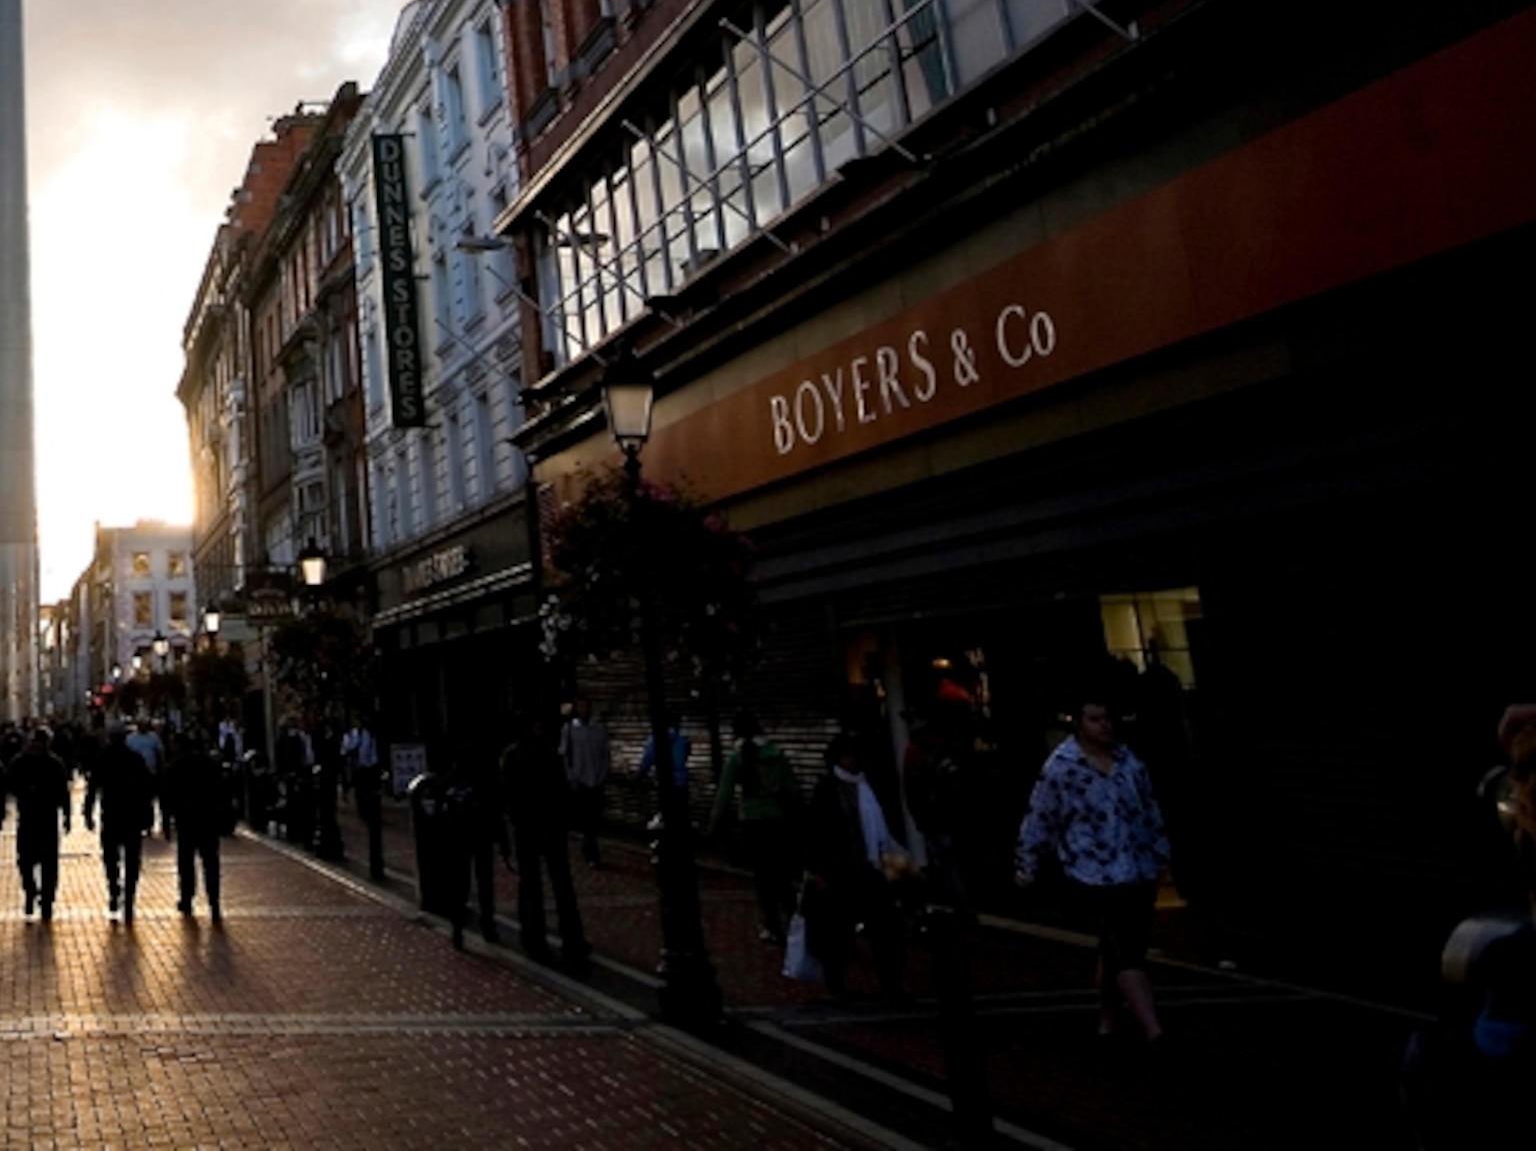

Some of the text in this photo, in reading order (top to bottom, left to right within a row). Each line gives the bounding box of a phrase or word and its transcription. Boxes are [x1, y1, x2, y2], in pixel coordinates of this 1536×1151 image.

[378, 138, 417, 418] DUNNES STORES
[770, 304, 1056, 455] BOYERS & Co
